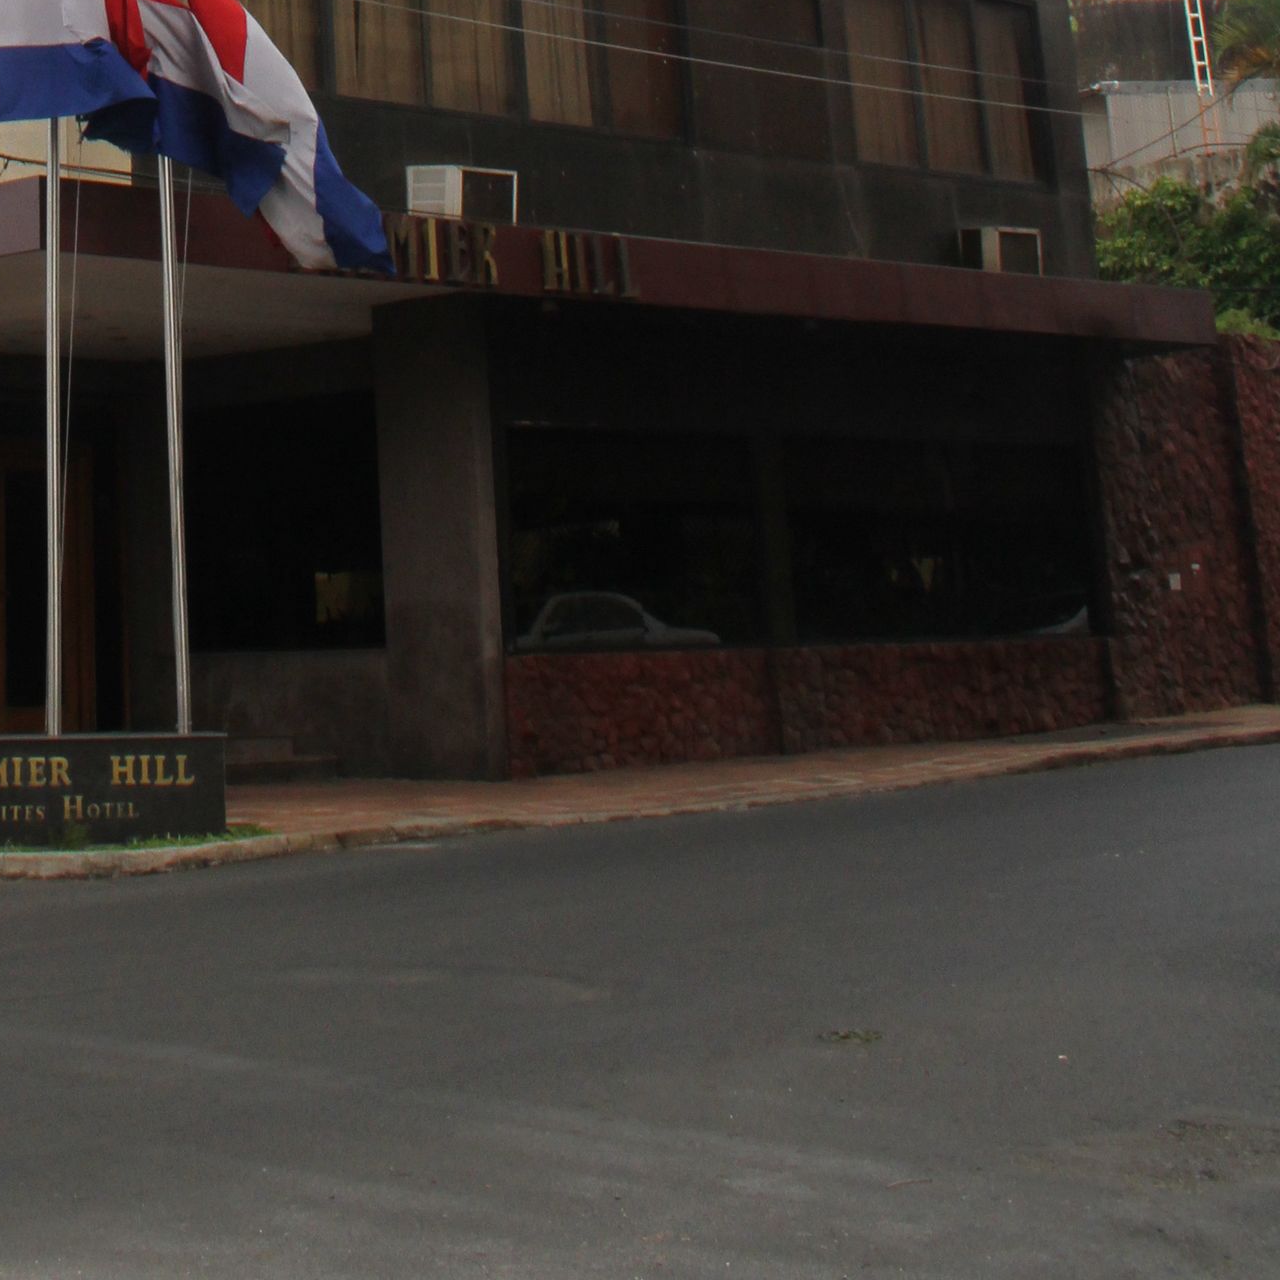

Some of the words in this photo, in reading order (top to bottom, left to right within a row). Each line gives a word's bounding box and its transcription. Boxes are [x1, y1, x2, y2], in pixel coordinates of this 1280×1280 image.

[340, 214, 499, 286] MIER
[541, 228, 640, 299] HILL
[110, 754, 195, 786] HILL
